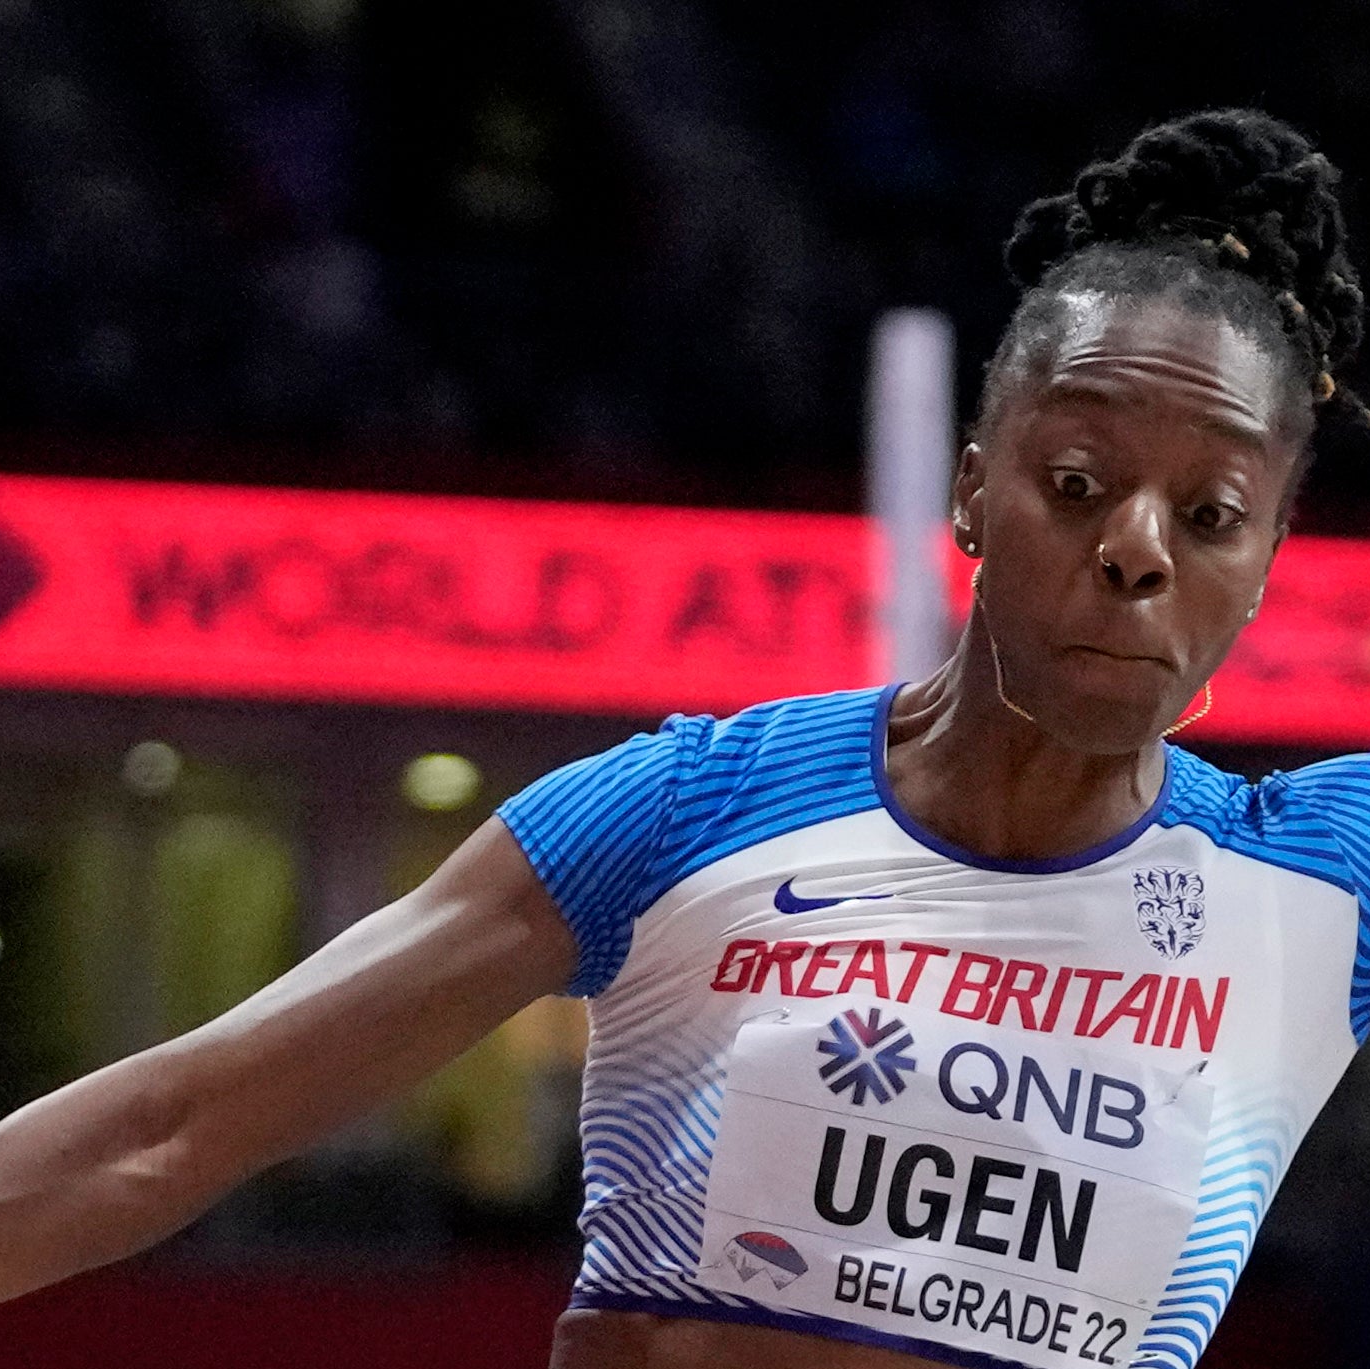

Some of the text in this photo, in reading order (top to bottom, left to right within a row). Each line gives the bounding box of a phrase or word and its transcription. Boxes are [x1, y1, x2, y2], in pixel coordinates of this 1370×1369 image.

[114, 534, 623, 654] WORLD
[710, 938, 1231, 1054] GREAT BRITAIN
[938, 1042, 1146, 1150] QNB
[813, 1125, 1098, 1274] UGEN
[834, 1254, 1128, 1366] BELGRADE 22
